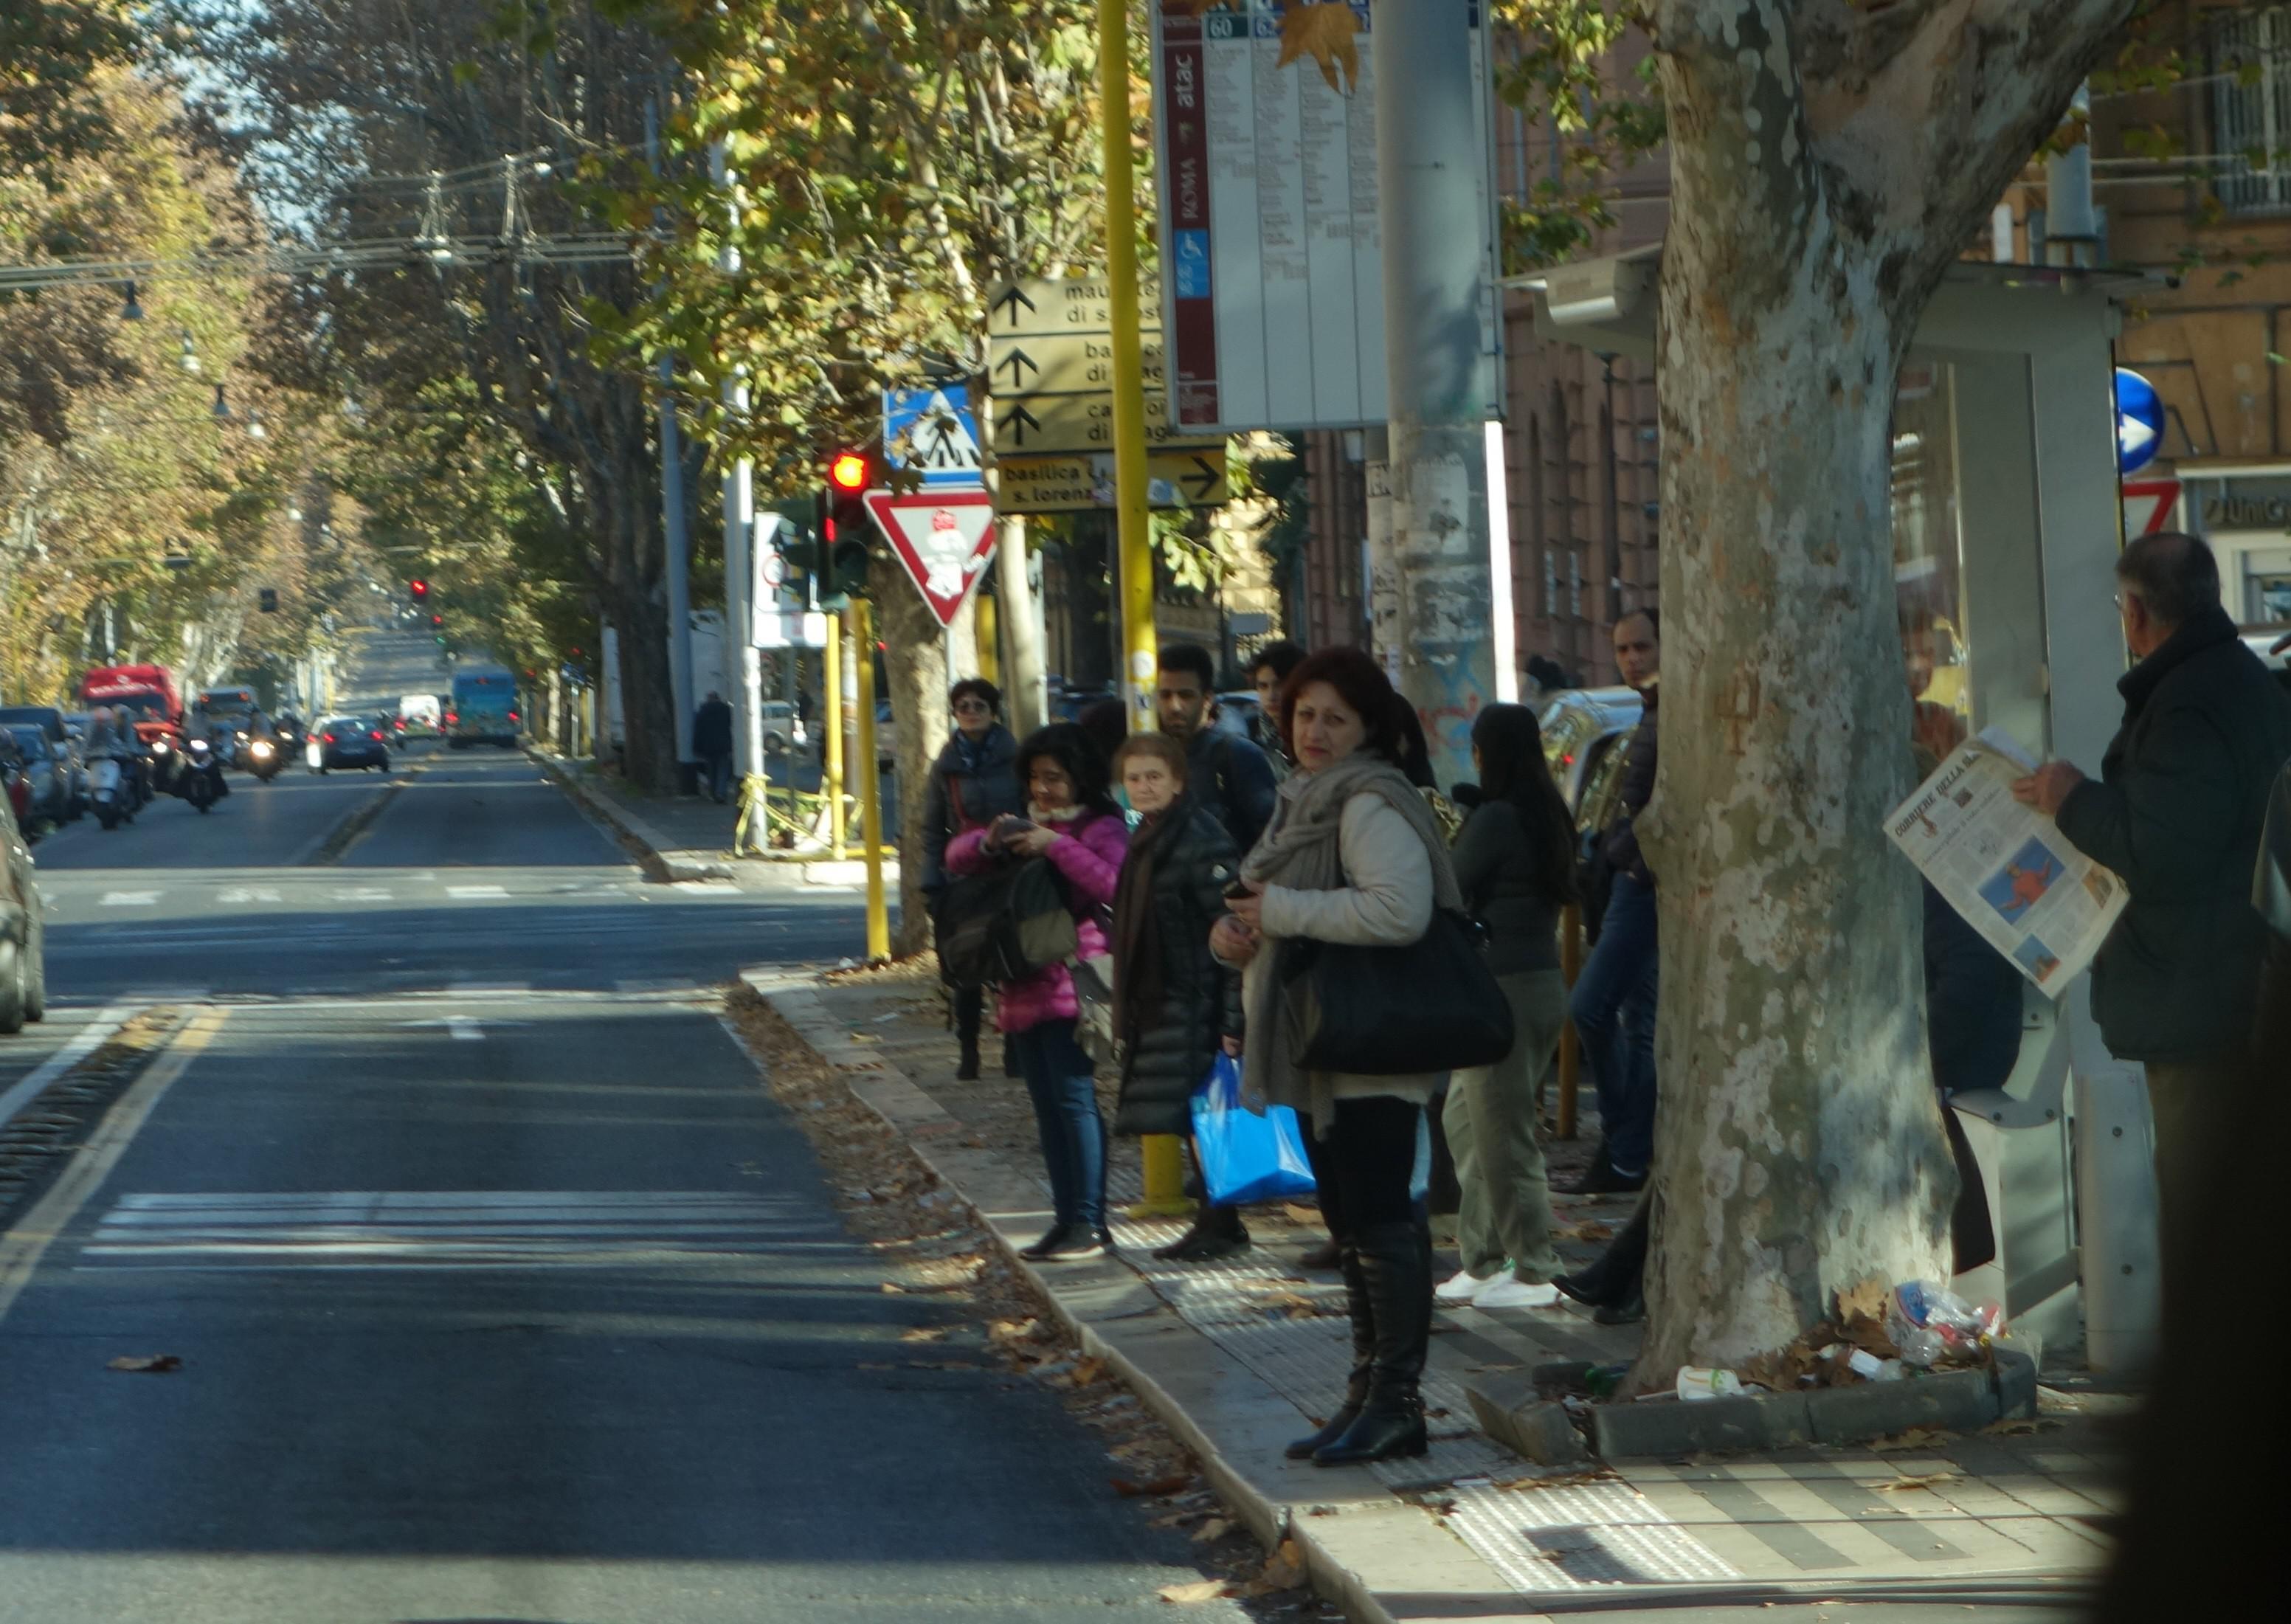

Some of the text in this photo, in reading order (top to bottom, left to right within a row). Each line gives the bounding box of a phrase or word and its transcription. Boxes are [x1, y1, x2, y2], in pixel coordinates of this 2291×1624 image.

[1209, 17, 1233, 37] 60
[1175, 52, 1199, 219] ROMA atac
[1067, 303, 1087, 323] di
[1087, 362, 1106, 381] di
[1088, 422, 1108, 441] di
[1005, 462, 1080, 481] basilica
[1893, 791, 1937, 838] CORRIERE
[1935, 766, 1965, 797] DELLA
